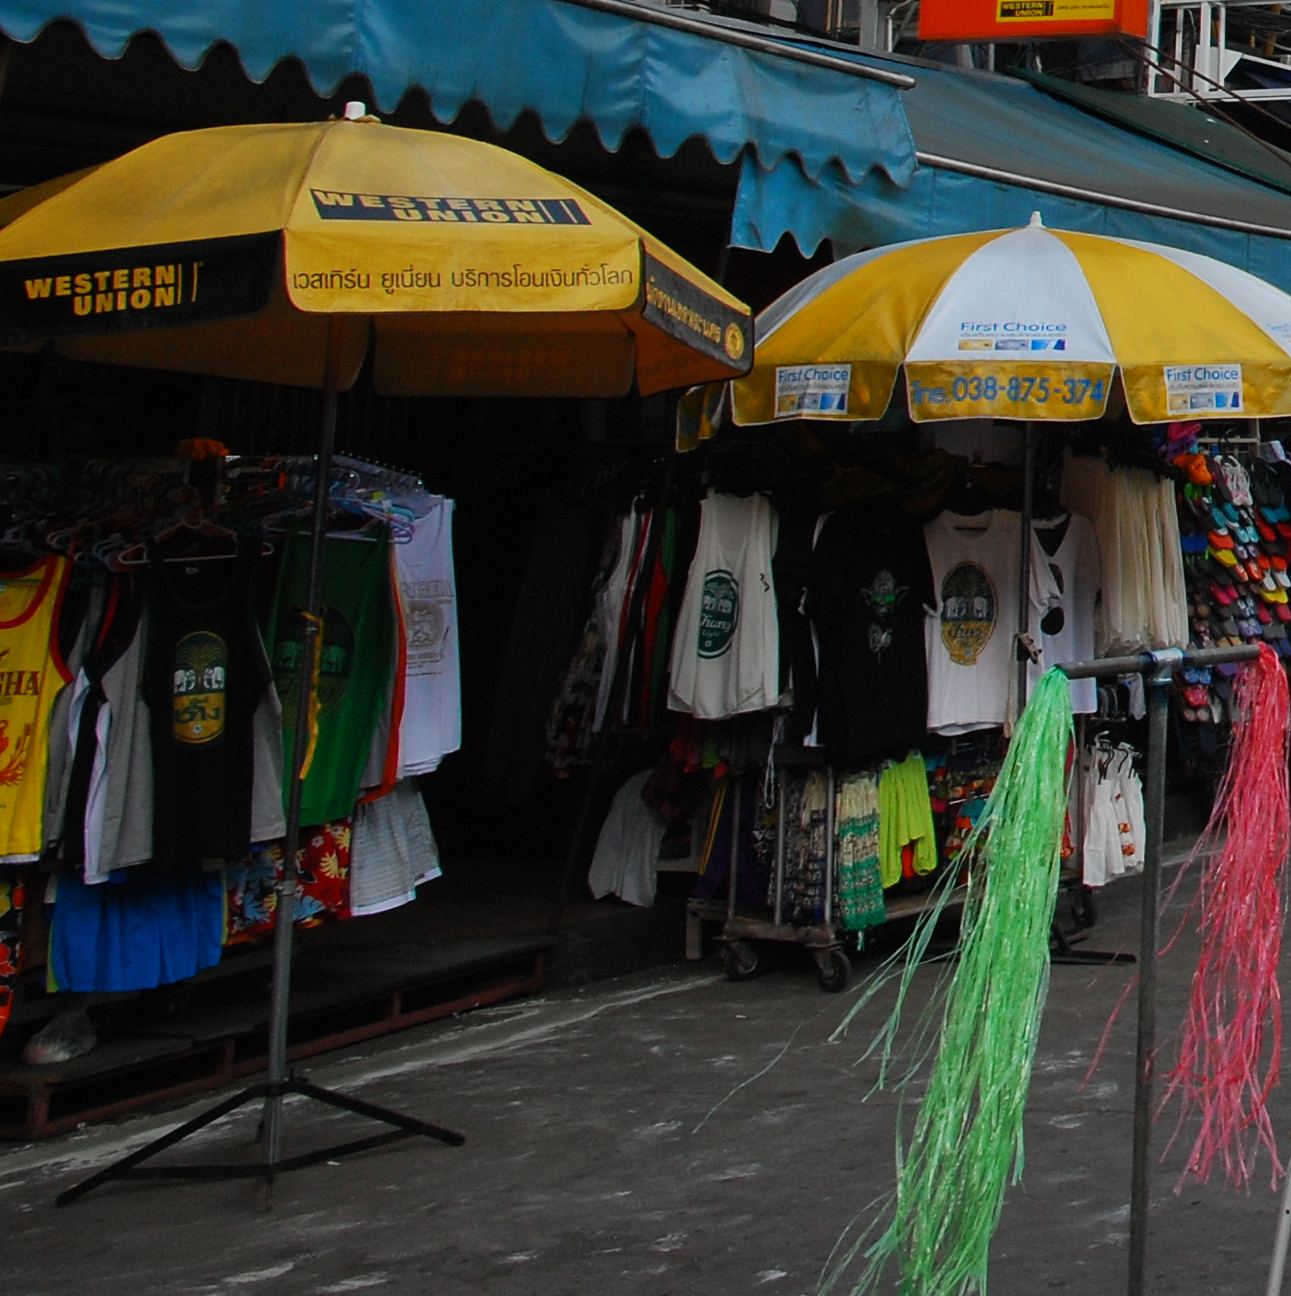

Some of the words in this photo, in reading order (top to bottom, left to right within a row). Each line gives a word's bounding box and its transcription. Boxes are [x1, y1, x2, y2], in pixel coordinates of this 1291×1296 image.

[1002, 1, 1044, 10] WESTERN
[1015, 9, 1043, 17] UNION
[313, 190, 539, 212] WESTERN
[391, 210, 549, 224] UNION
[25, 265, 177, 300] WESTERN
[293, 268, 371, 290] เวสเทิร์น
[381, 265, 441, 295] ยูเนี่ยน
[451, 262, 633, 289] บริการโอนเงินทั่วโลก
[73, 286, 176, 317] UNION
[960, 321, 997, 332] First
[1003, 321, 1067, 332] Choice
[778, 370, 802, 383] First
[804, 369, 848, 382] Choice
[1167, 368, 1192, 381] First
[1194, 367, 1239, 381] Choice
